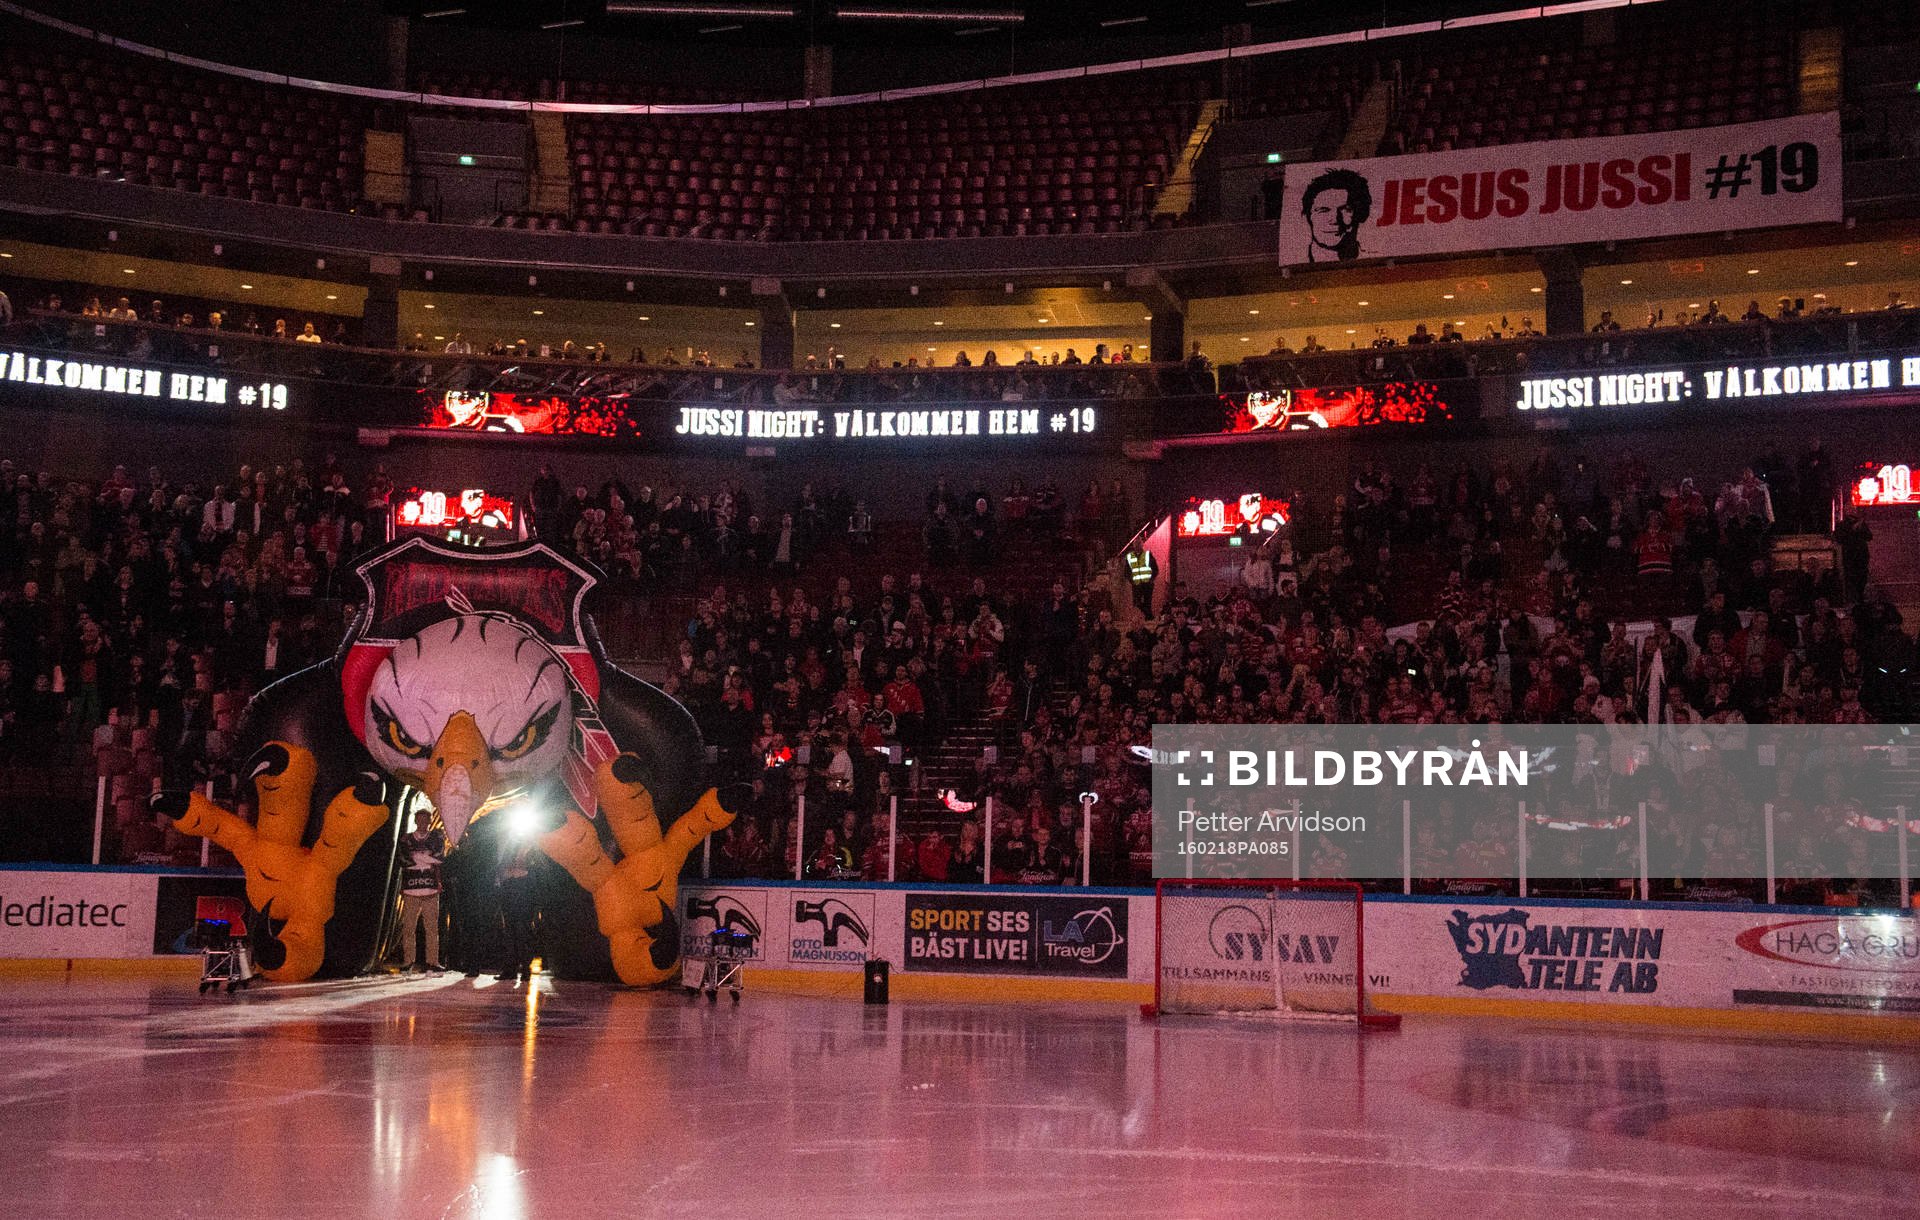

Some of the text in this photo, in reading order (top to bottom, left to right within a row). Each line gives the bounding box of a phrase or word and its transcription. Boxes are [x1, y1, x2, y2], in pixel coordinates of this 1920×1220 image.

[1376, 141, 1819, 227] JESUS JUSSI #19
[170, 373, 228, 404] HEM
[238, 383, 288, 410] #19
[1516, 376, 1594, 410] JUSSI
[1599, 371, 1692, 405] NIGHT:
[1704, 359, 1890, 399] VÄLKOMMEN
[675, 407, 1095, 437] JUSSI NIGHT: VÄLKOMMEN HEM #19
[0, 895, 127, 928] ediatec
[910, 908, 1031, 932] SPORT SES
[792, 938, 822, 950] OTTO
[1043, 920, 1085, 943] LA
[1776, 931, 1858, 956] HAGA
[792, 949, 867, 962] MAGNUSSON
[911, 932, 1028, 961] BÄST LIVE!
[1044, 942, 1096, 958] Travel
[1527, 957, 1658, 994] TELE AB
